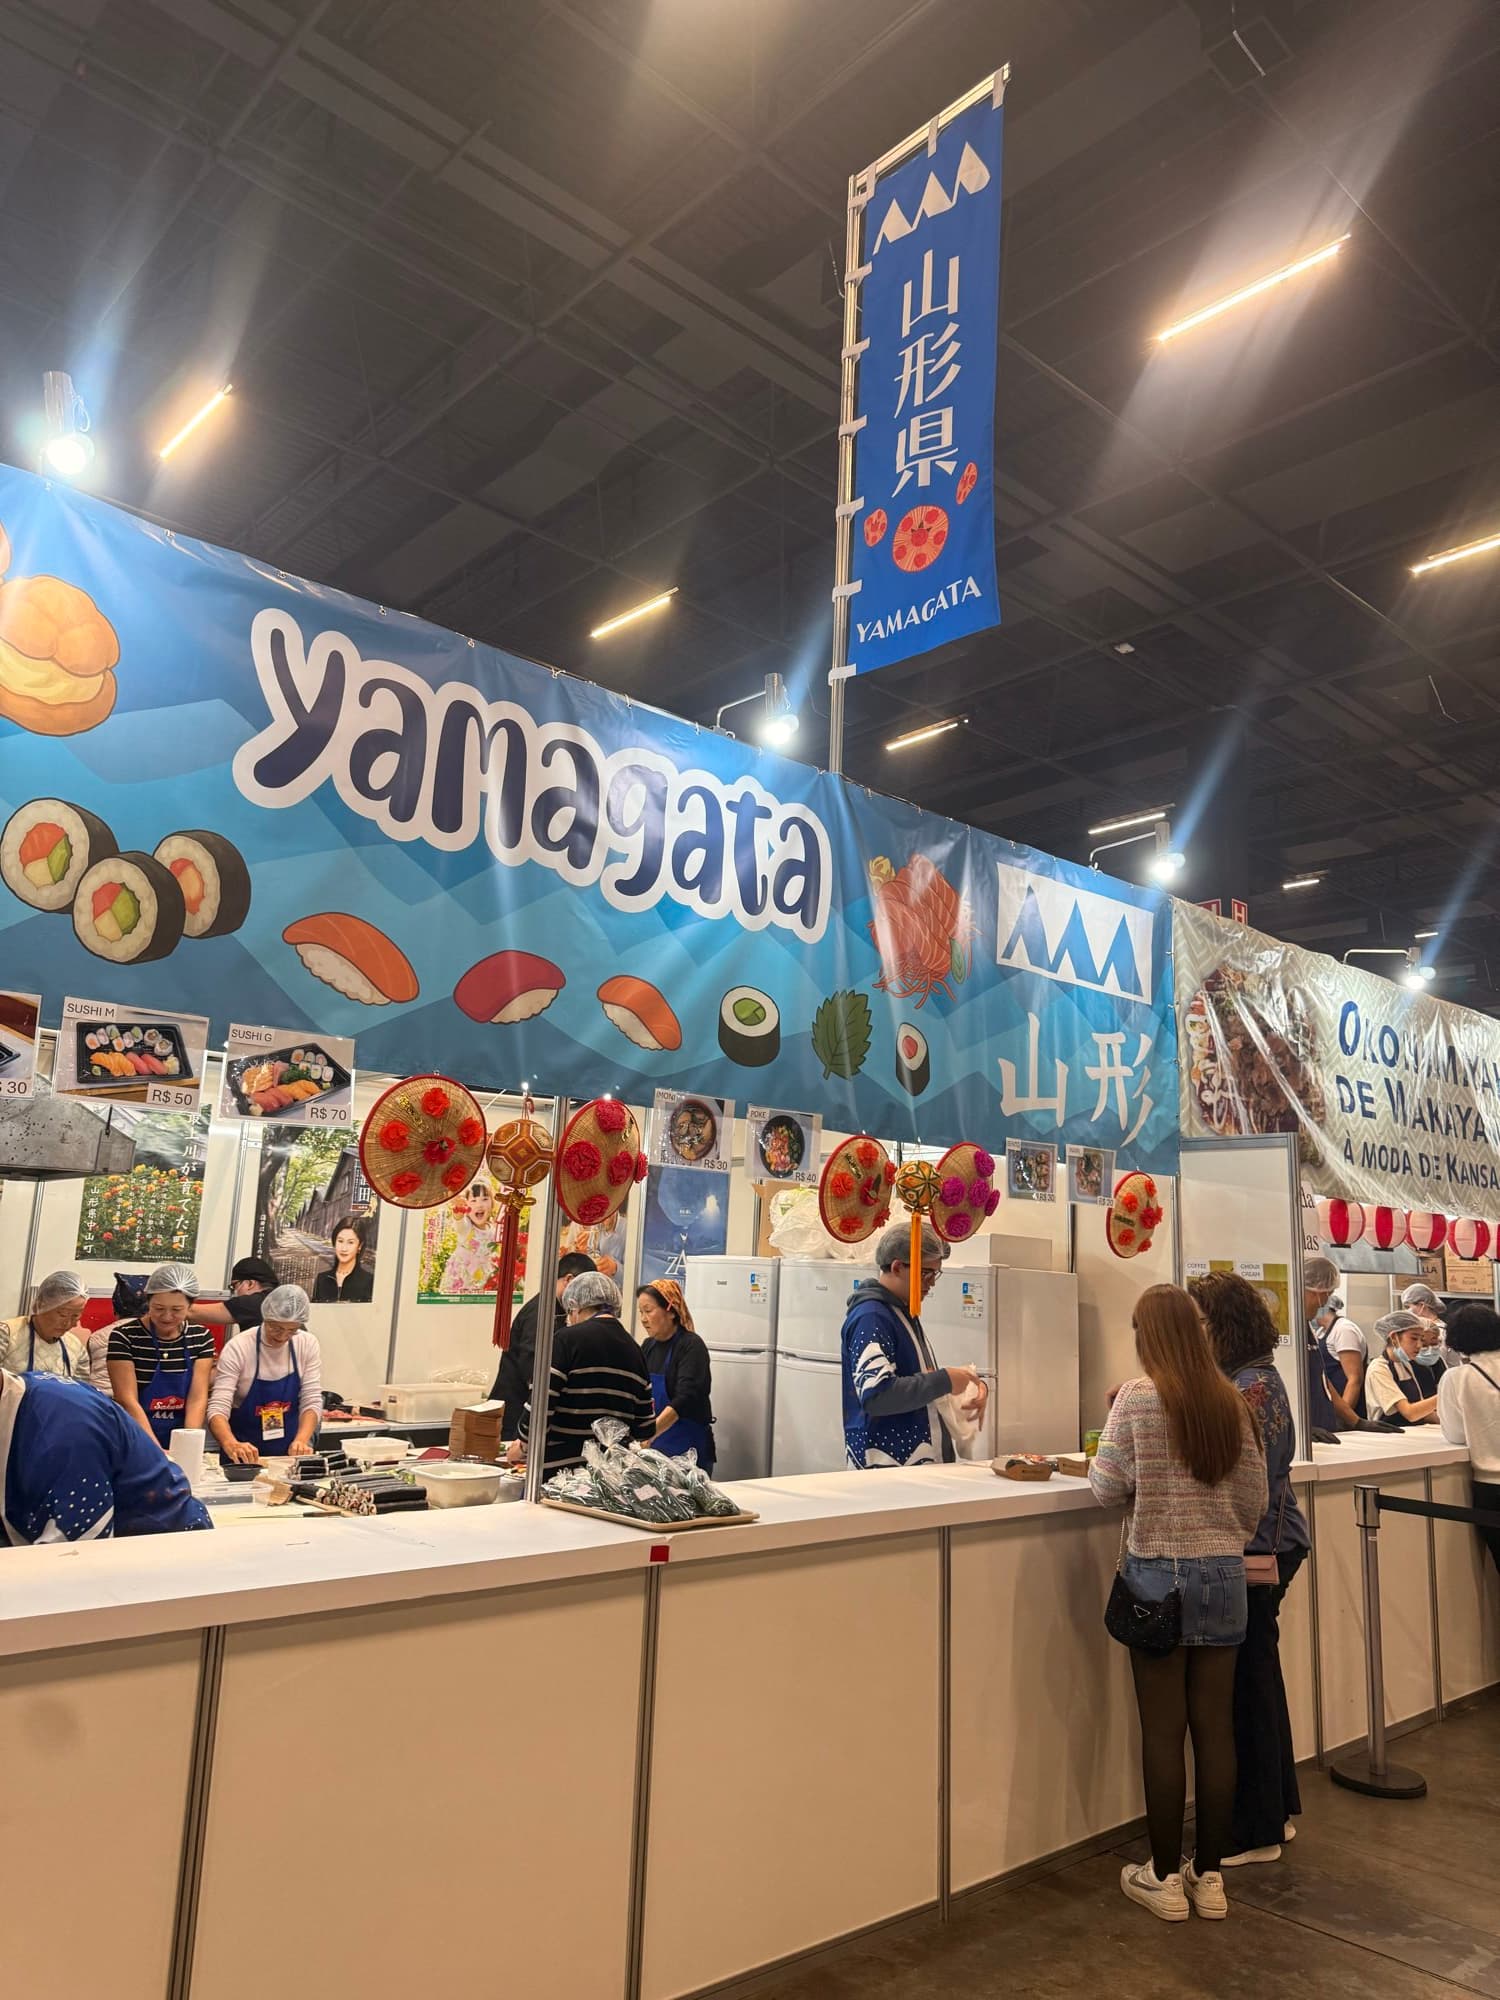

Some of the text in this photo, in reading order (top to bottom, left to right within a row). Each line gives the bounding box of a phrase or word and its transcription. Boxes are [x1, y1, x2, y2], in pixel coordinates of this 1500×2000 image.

[892, 249, 961, 498] 山形県
[856, 575, 982, 643] YAMAGATA
[254, 628, 821, 931] yamagata
[66, 1002, 115, 1017] SUSHI M
[231, 1028, 273, 1042] SUSHI G
[7, 1081, 27, 1094] 30
[998, 1012, 1154, 1148] 山形
[152, 1089, 192, 1106] R$ 50
[310, 1107, 347, 1121] R$ 70
[1335, 1074, 1499, 1146] DE WAKAYA
[1343, 1129, 1354, 1166] À
[1361, 1141, 1414, 1177] MODA
[1418, 1152, 1442, 1181] DE
[704, 1158, 728, 1171] R$ 30
[795, 1171, 817, 1183] R$ 40
